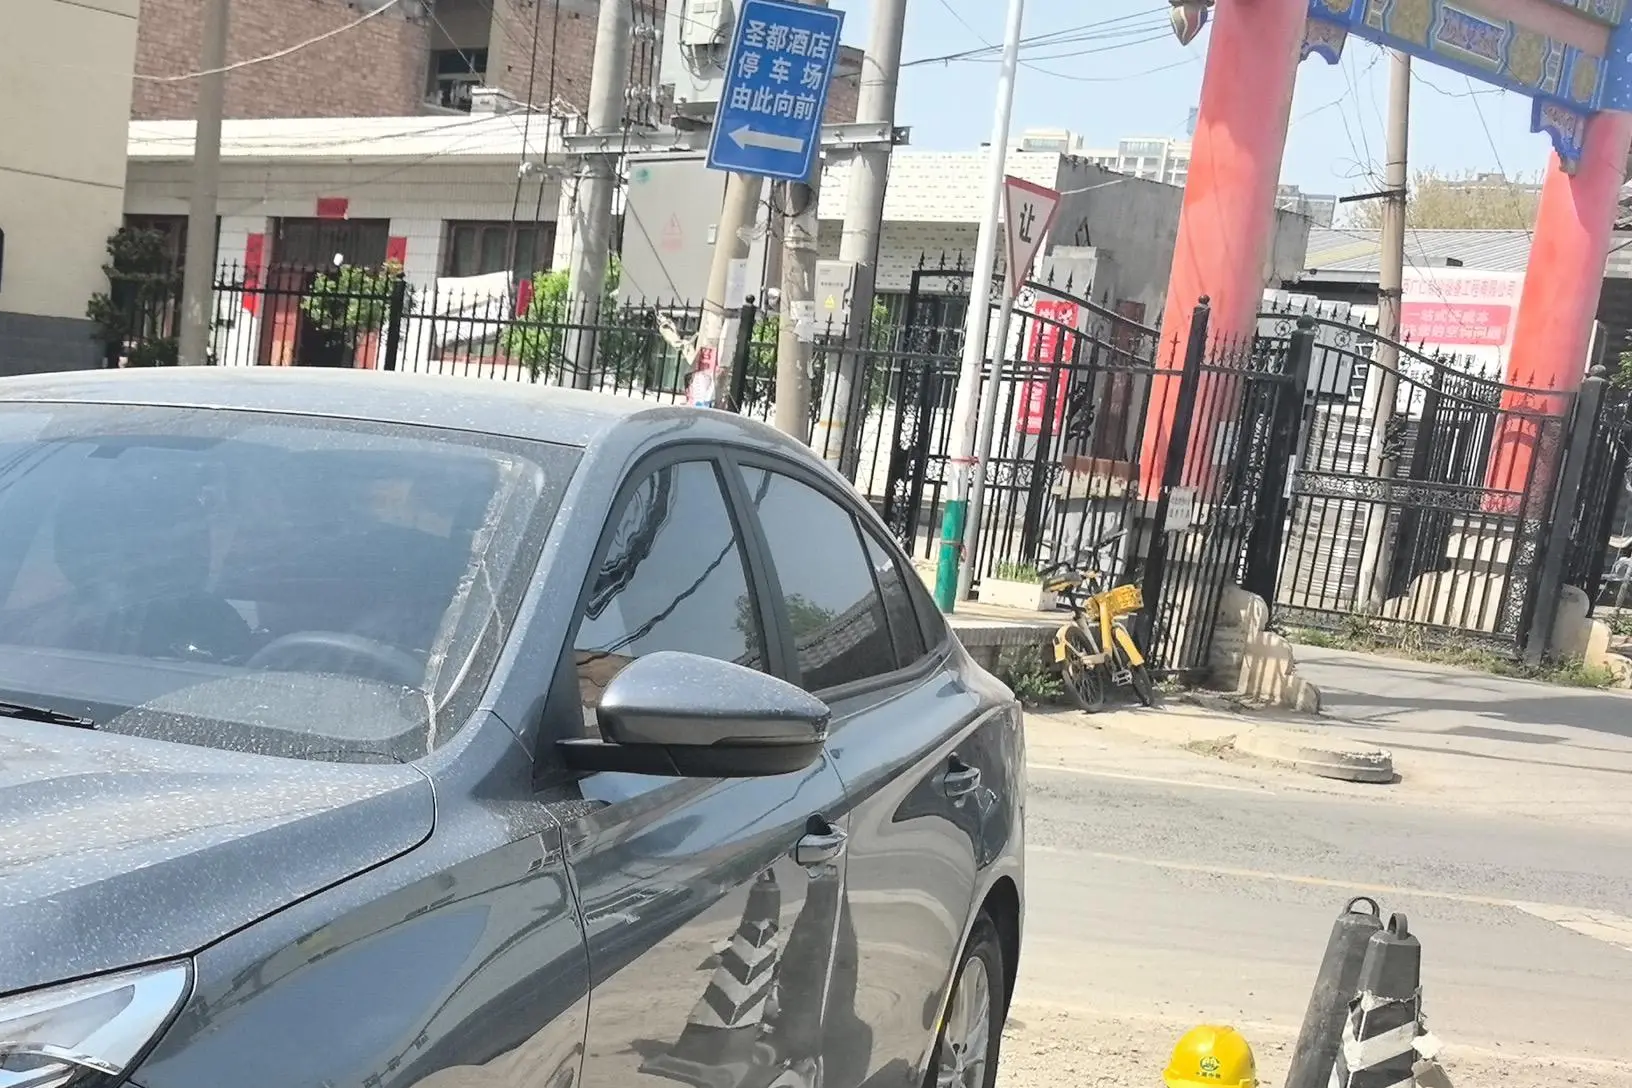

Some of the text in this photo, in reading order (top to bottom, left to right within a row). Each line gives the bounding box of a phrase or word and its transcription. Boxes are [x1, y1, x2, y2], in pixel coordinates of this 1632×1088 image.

[743, 19, 831, 60] 圣都酒店
[737, 51, 823, 91] 停车场
[730, 82, 817, 121] 由此向前
[1019, 202, 1036, 244] 让
